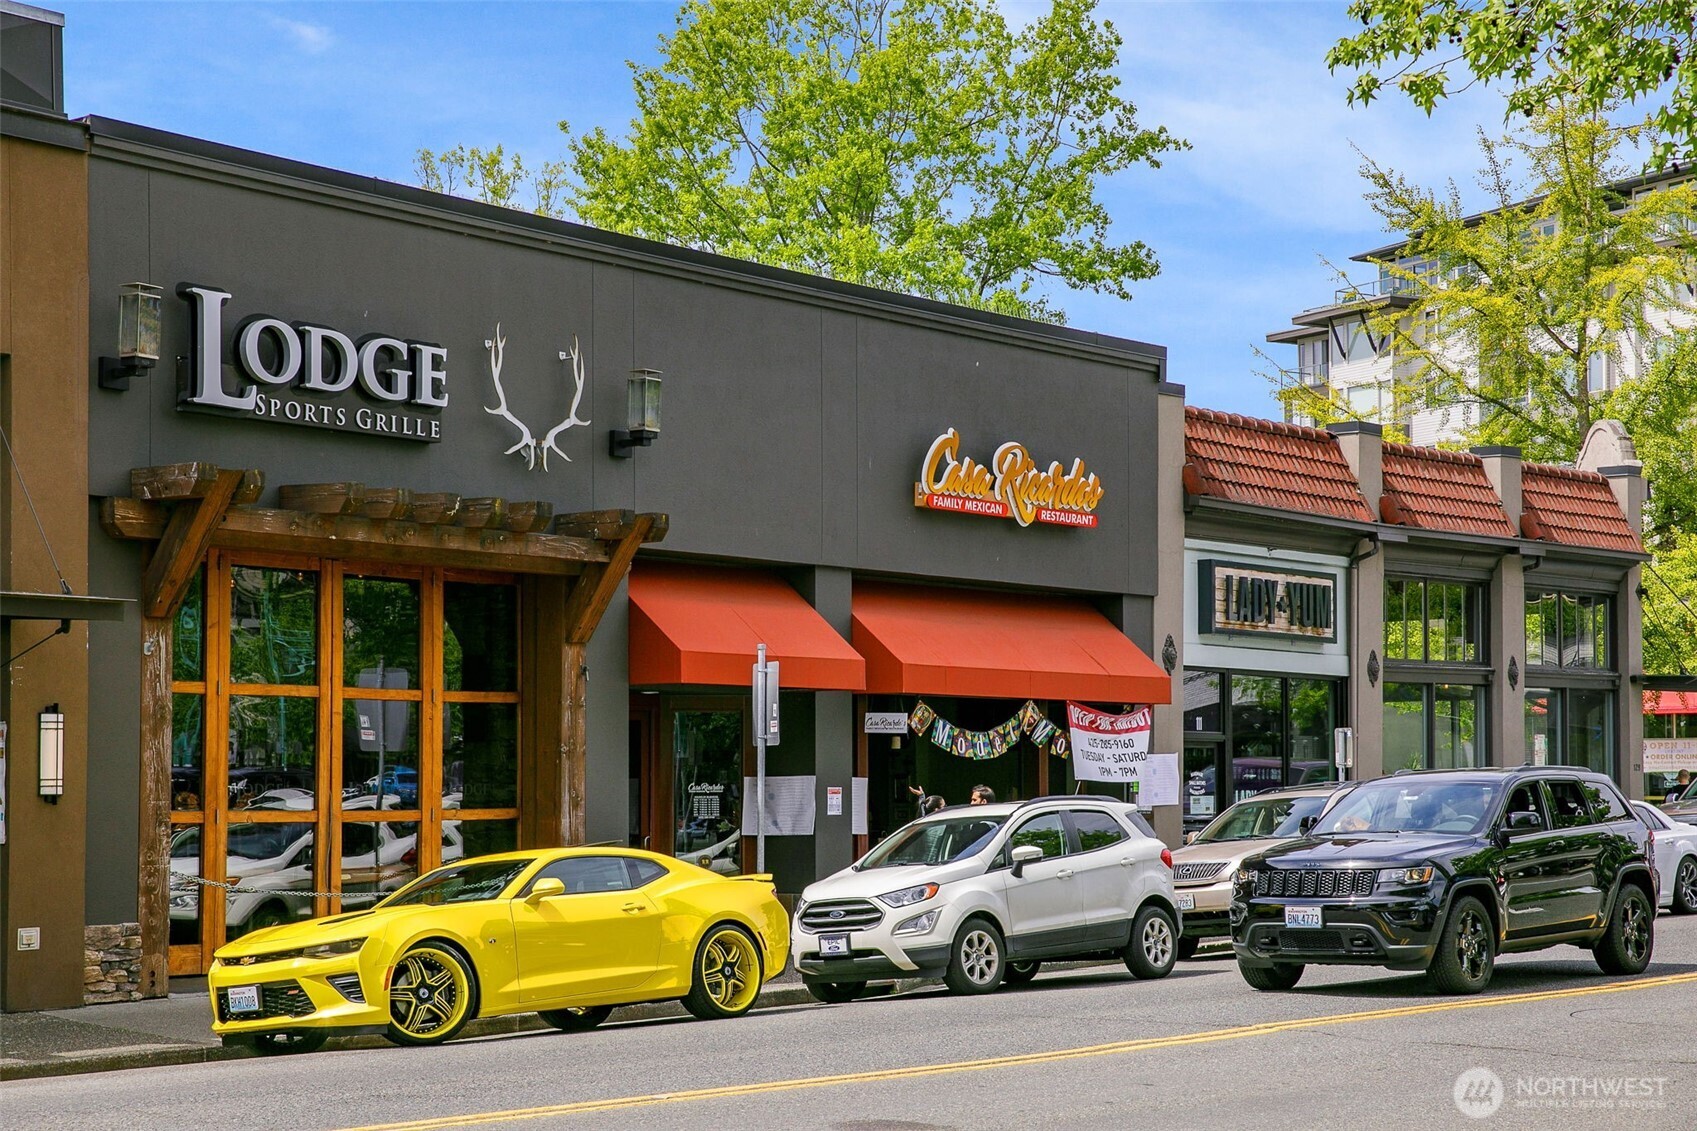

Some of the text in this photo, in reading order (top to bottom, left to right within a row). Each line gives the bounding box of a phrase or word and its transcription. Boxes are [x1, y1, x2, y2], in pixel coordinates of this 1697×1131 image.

[184, 286, 449, 411] LODGE
[255, 393, 441, 438] SPORTS GRILLE
[921, 427, 994, 500] Casa
[932, 495, 1004, 515] FAMILY MEXICAN
[1040, 509, 1094, 526] RESTAURANT
[1225, 574, 1332, 629] LADY YUM
[1087, 737, 1135, 750] 425-285-9160
[1650, 741, 1678, 750] OPEN
[1080, 748, 1106, 763] TUESDAY
[1112, 751, 1148, 764] SATURD
[1098, 766, 1113, 777] 1PM
[1119, 766, 1138, 777] 7PM
[1287, 913, 1319, 925] BNL4773
